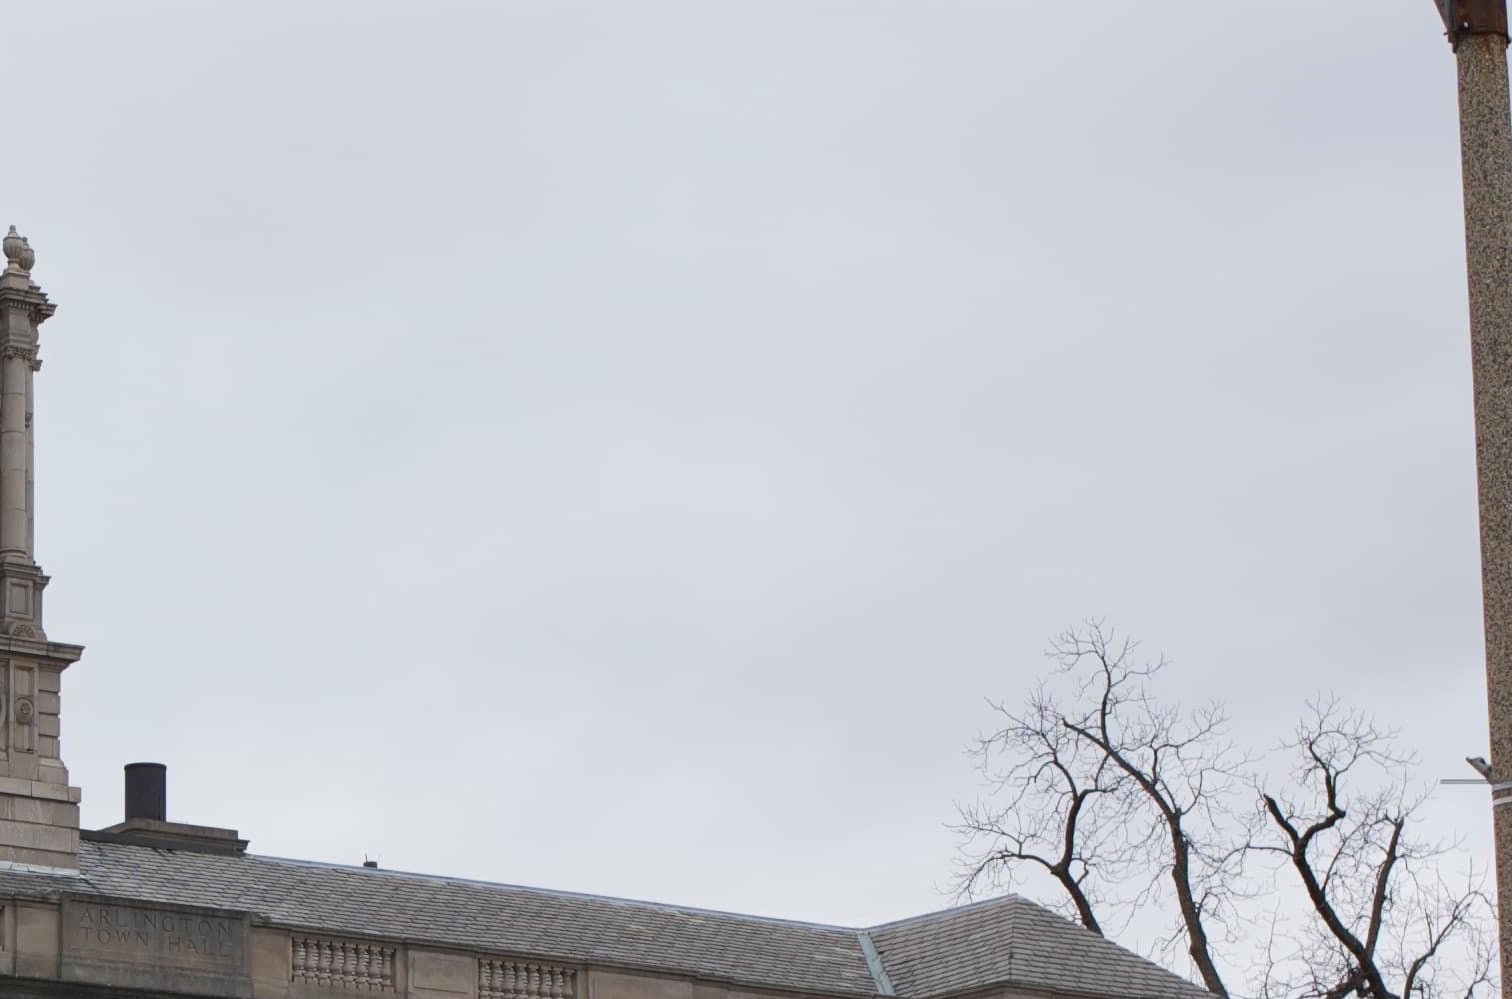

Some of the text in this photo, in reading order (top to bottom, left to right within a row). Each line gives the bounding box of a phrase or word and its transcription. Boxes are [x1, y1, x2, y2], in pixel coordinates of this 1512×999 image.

[79, 906, 232, 938] ARLINGTON
[79, 926, 233, 957] TOWN HALL
